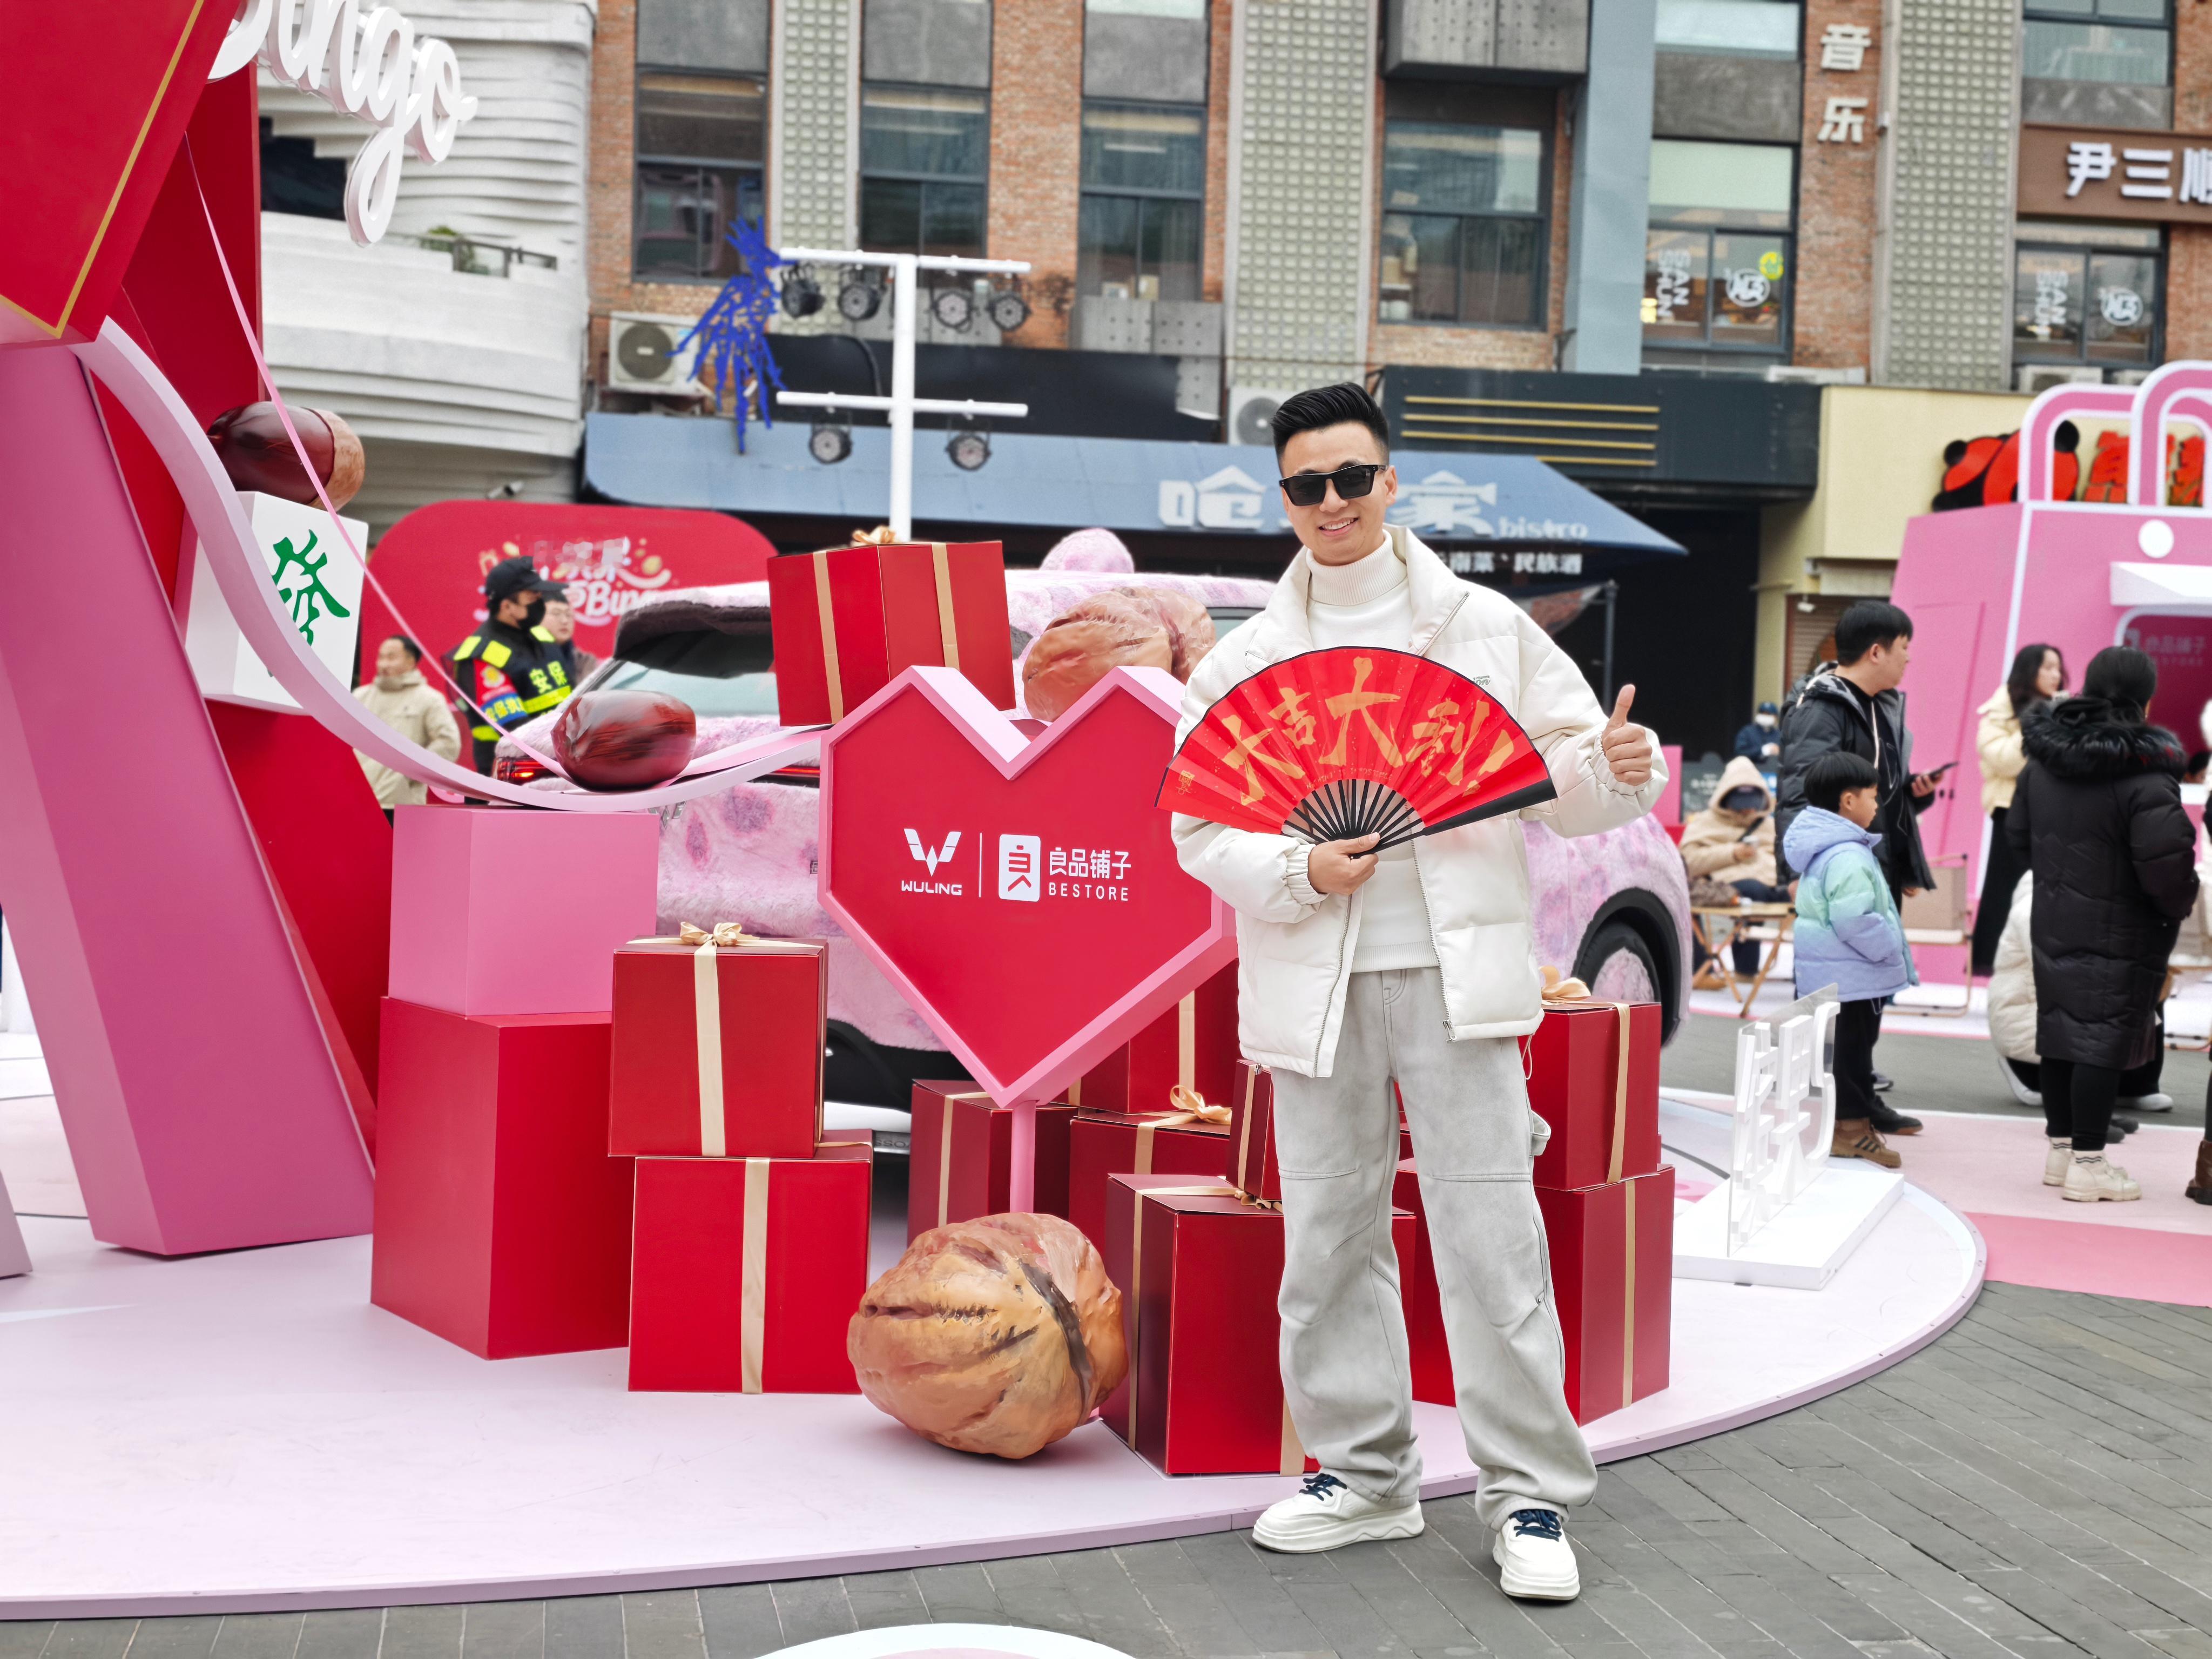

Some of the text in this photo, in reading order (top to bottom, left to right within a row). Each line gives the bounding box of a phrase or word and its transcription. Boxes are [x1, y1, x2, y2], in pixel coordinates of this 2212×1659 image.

[1817, 23, 1872, 143] 音乐
[208, 0, 478, 246] ingo
[1499, 516, 1589, 538] bistro
[1438, 550, 1582, 575] 南菜、民族酒
[529, 661, 567, 694] 安保
[1220, 656, 1514, 806] 大吉大利
[1049, 847, 1131, 880] 良品铺子
[901, 880, 962, 896] WULING
[1049, 882, 1129, 901] BESTORE
